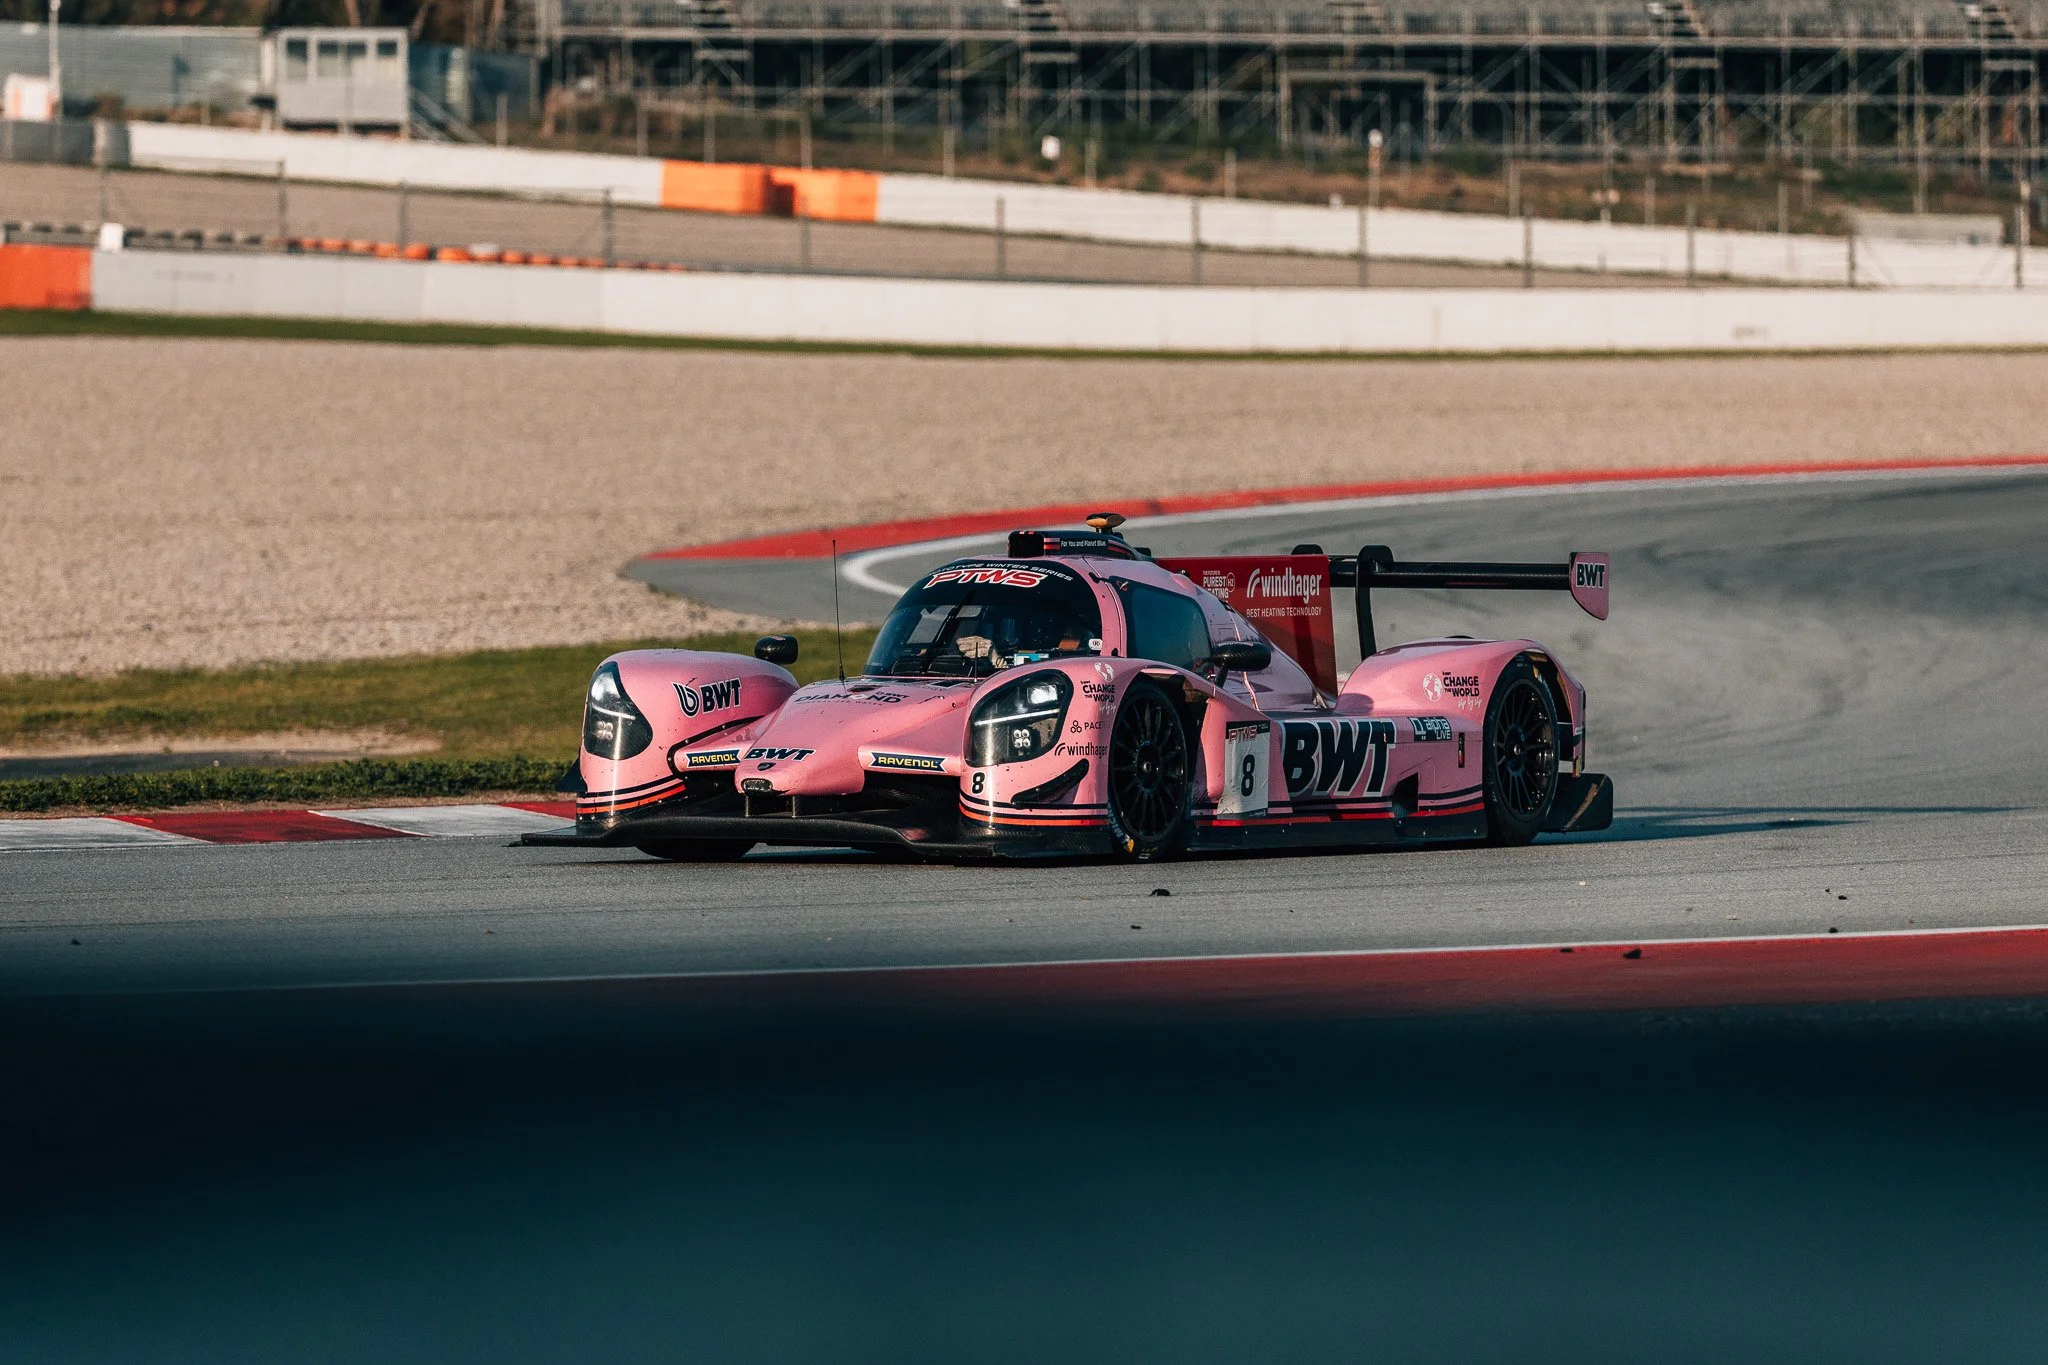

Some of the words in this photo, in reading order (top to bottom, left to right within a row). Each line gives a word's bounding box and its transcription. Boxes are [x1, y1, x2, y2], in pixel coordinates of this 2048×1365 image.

[923, 567, 1048, 588] PTWS
[1030, 566, 1074, 581] SERIES
[1576, 562, 1605, 588] BWT
[1203, 576, 1226, 587] PUREST
[1261, 567, 1322, 604] windhager
[1247, 608, 1260, 617] BEST
[1262, 607, 1285, 617] HEATING
[1286, 607, 1322, 616] TECHNOLOGY
[1083, 684, 1115, 694] CHANGE
[1444, 676, 1479, 687] CHANGE
[700, 678, 742, 714] BWT
[1093, 694, 1115, 702] WORLD
[1452, 688, 1480, 697] WORLD
[1423, 718, 1450, 734] alpha
[1228, 725, 1257, 743] PTWS
[1436, 730, 1451, 739] LIVE
[744, 748, 816, 761] BWT
[1067, 742, 1108, 759] windhager
[1280, 718, 1396, 796] BWT
[691, 754, 736, 764] RAVENOL
[878, 757, 938, 768] RAVENOL
[972, 771, 985, 794] 8
[1241, 754, 1255, 796] 8
